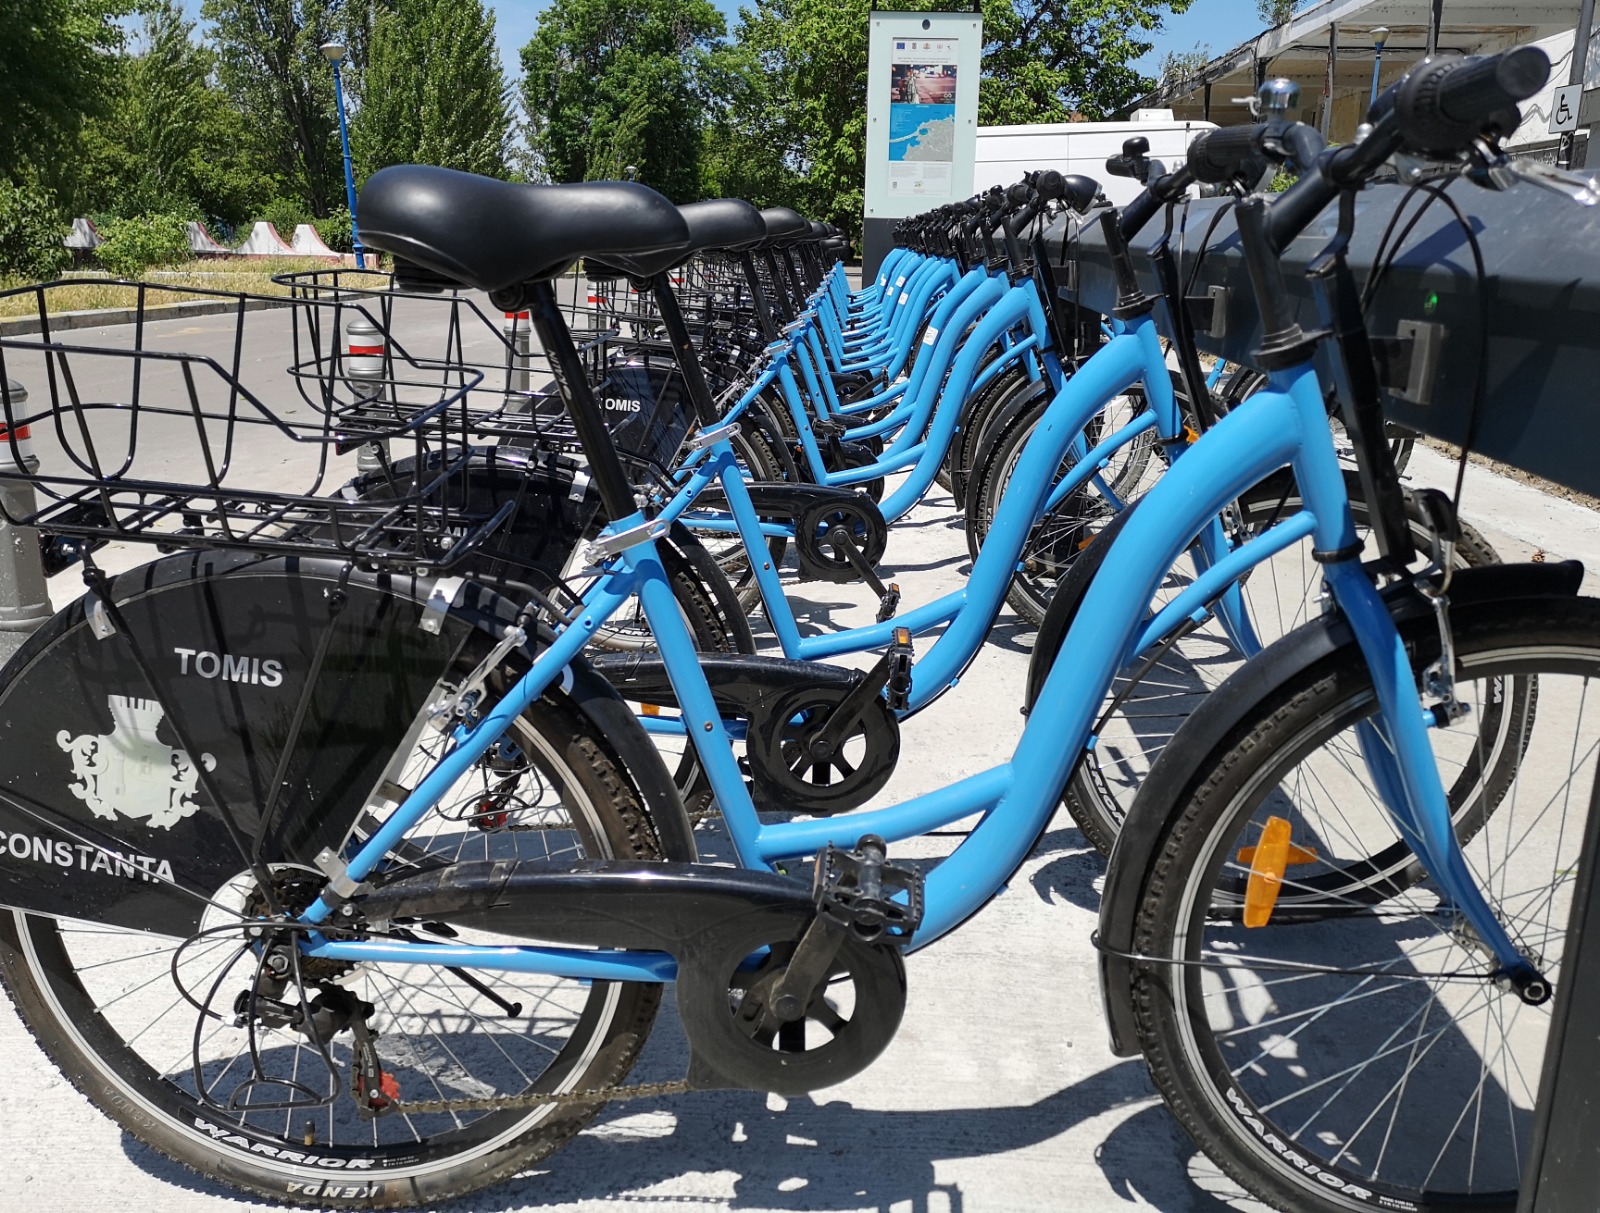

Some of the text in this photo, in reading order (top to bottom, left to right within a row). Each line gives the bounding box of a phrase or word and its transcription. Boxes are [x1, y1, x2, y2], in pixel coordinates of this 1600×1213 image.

[604, 398, 641, 412] OMIS
[174, 647, 283, 687] TOMIS
[1086, 753, 1125, 825] RRIOR
[103, 1086, 158, 1130] KENDA
[194, 1117, 376, 1169] WARRIOR
[1226, 1086, 1373, 1200] WARRIOR
[286, 1181, 379, 1198] KENDA
